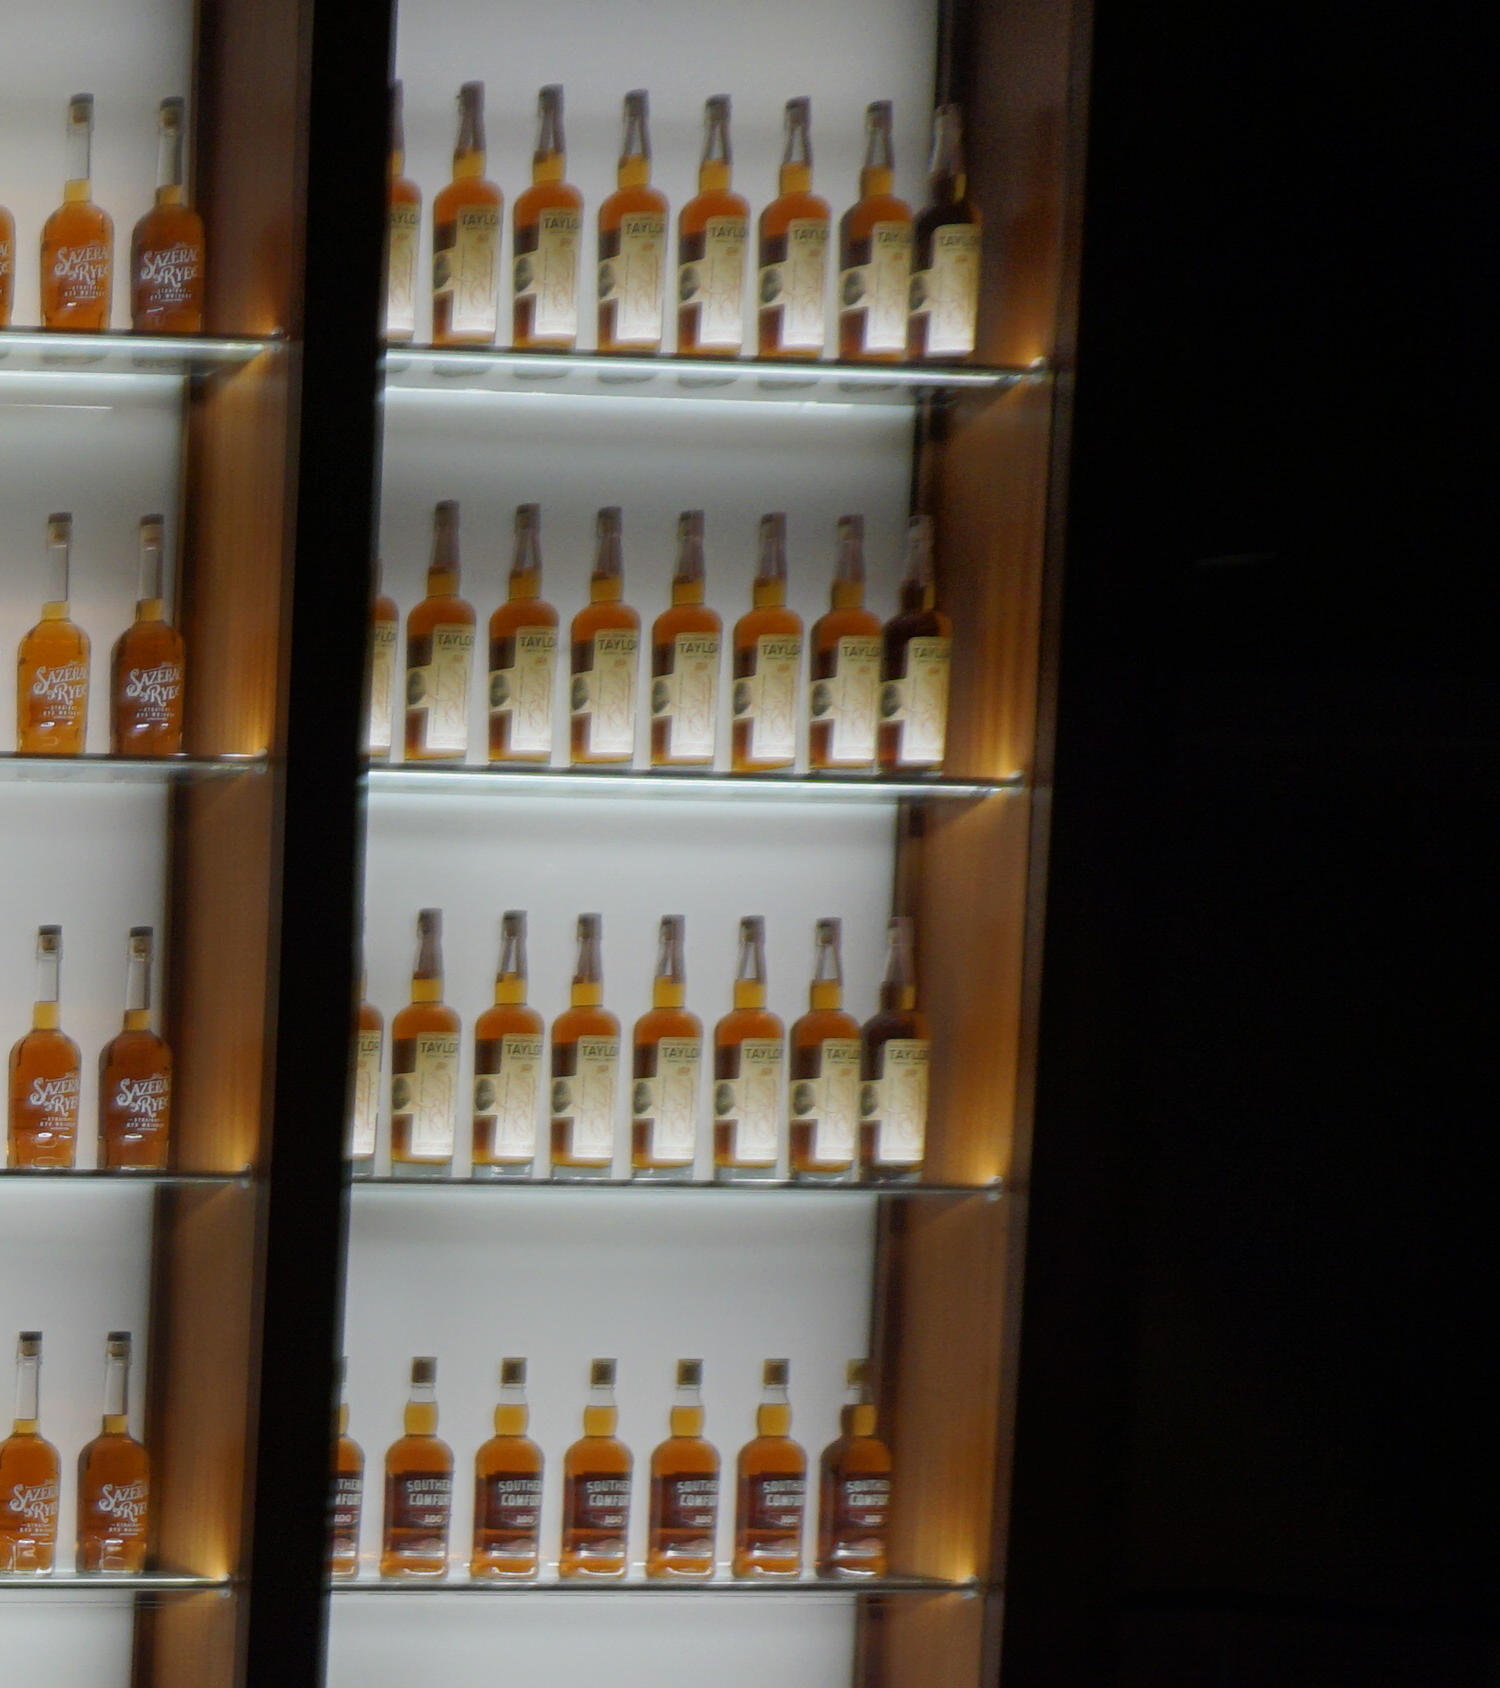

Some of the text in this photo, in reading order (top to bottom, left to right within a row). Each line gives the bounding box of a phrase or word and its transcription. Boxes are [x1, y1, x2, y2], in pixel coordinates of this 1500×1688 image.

[74, 263, 104, 283] RYE
[159, 266, 190, 288] RYE
[54, 684, 81, 705] RYE
[148, 685, 175, 706] RYE
[116, 1077, 171, 1105] SAZERA
[52, 1094, 77, 1115] RYE
[137, 1095, 165, 1116] RYE
[406, 1480, 451, 1492] SOUTHE
[410, 1494, 450, 1505] COMF
